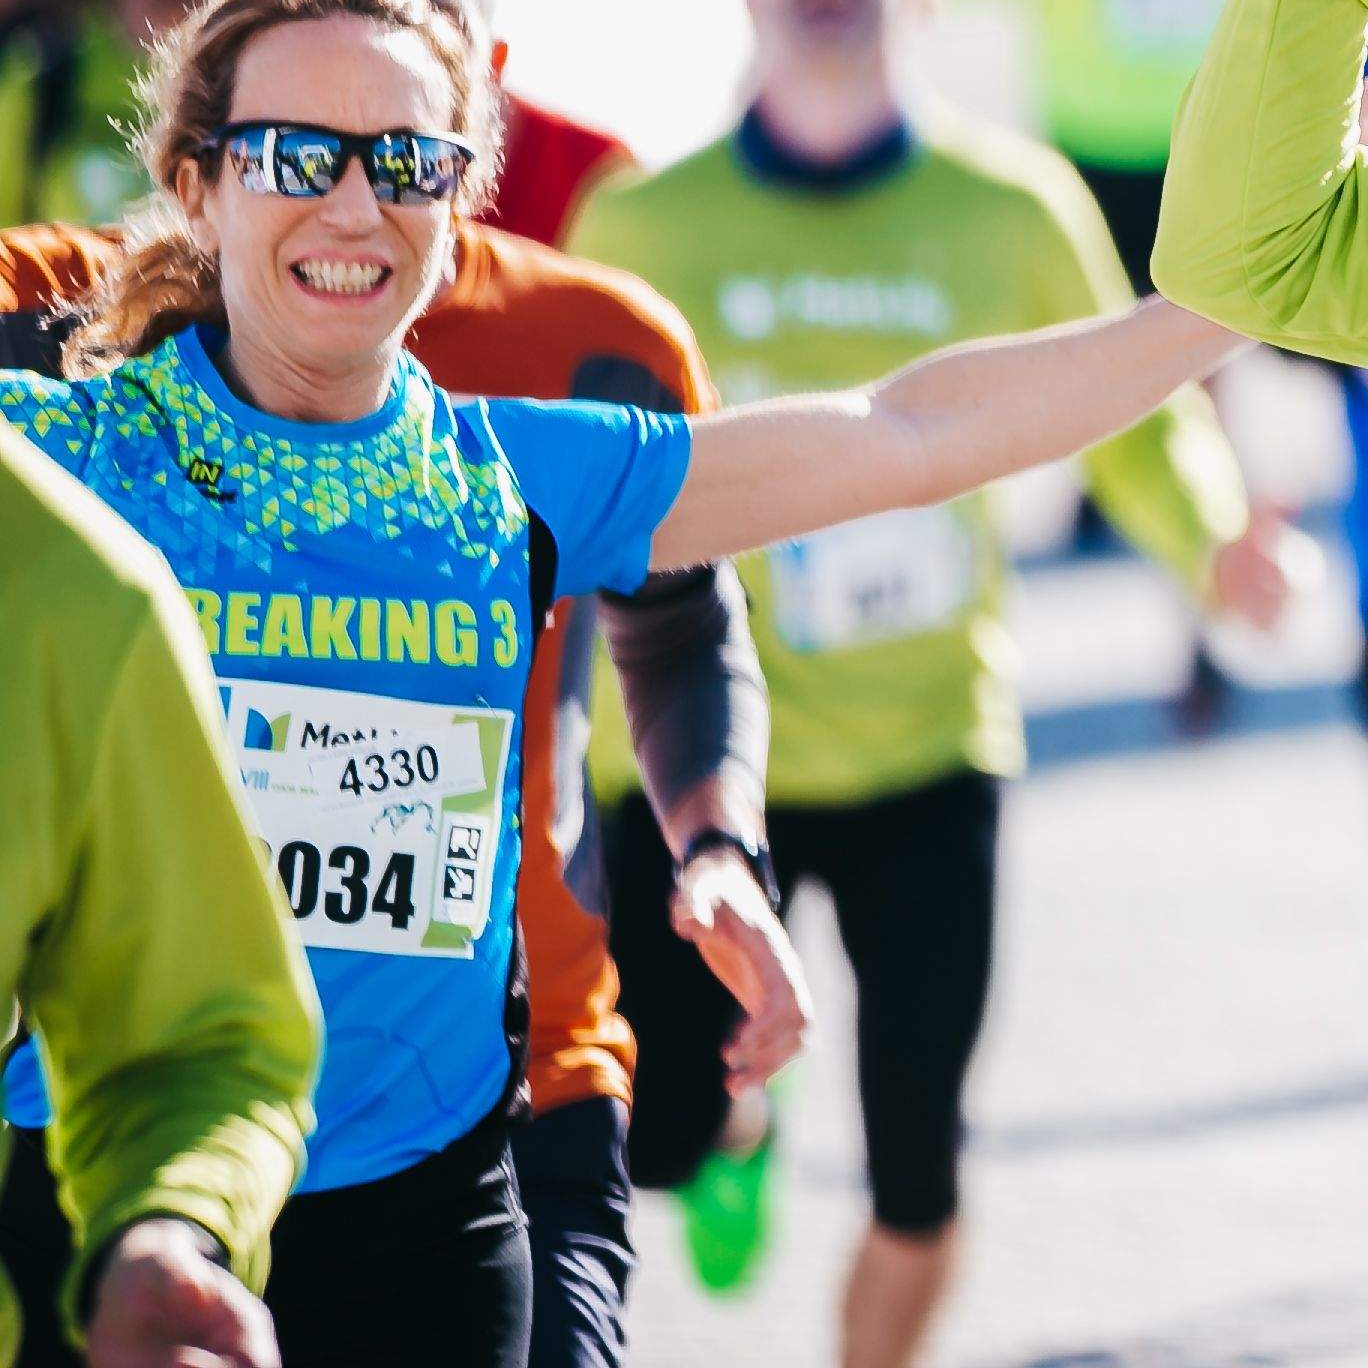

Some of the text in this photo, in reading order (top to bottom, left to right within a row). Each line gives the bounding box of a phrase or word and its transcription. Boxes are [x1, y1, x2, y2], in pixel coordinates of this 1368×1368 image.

[182, 586, 519, 670] REAKING 3
[339, 743, 439, 798] 4330
[262, 838, 416, 930] 034
